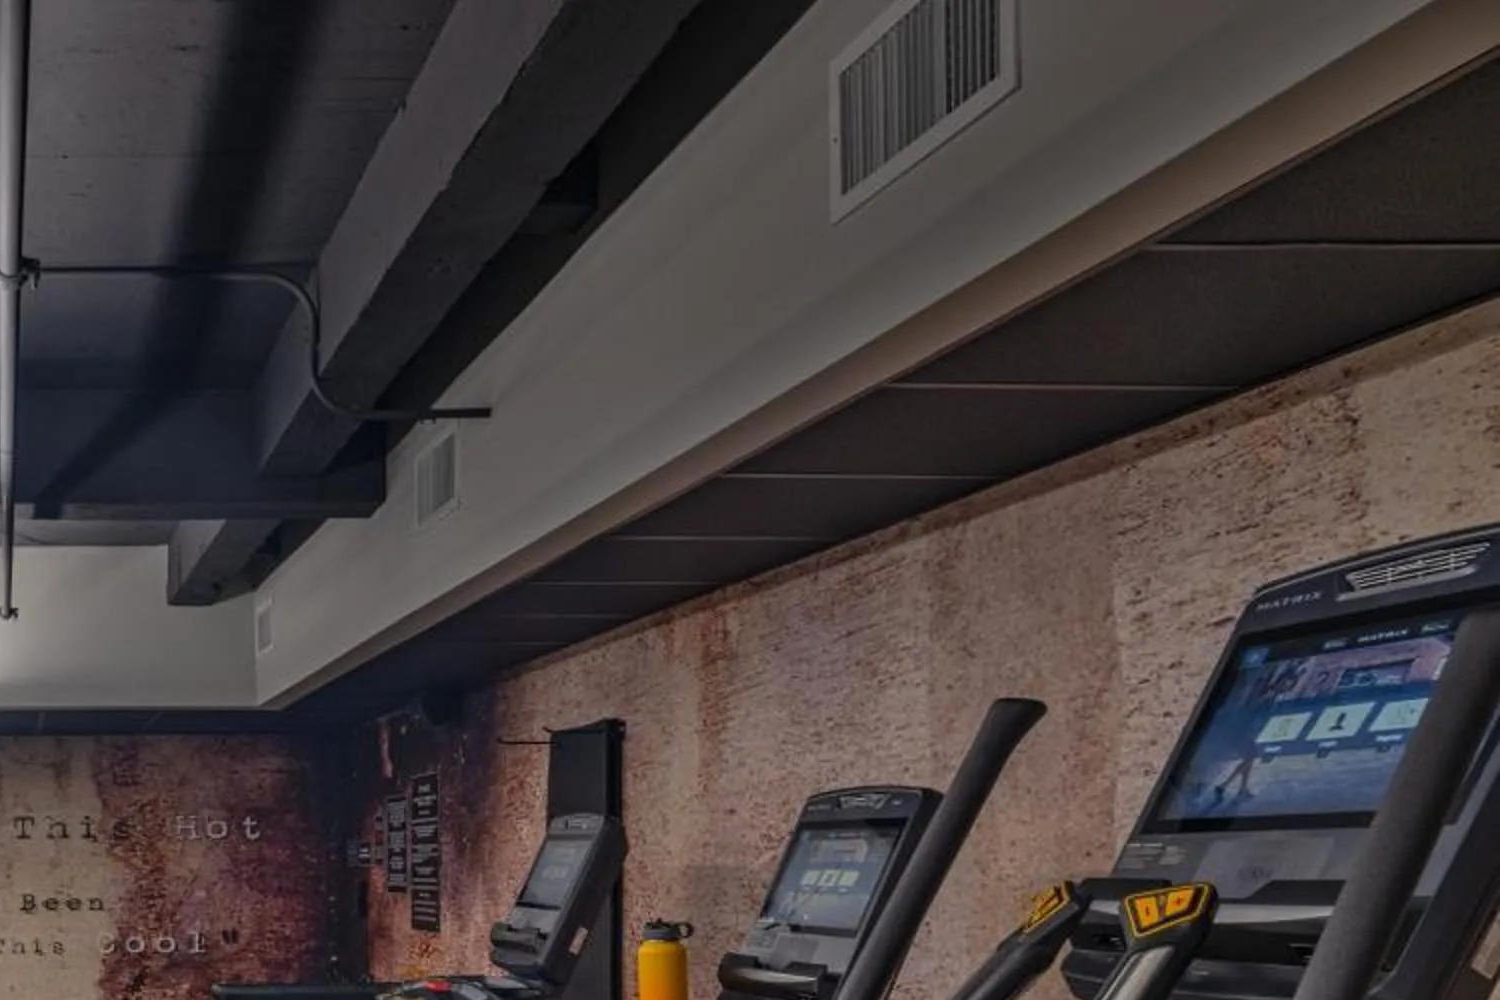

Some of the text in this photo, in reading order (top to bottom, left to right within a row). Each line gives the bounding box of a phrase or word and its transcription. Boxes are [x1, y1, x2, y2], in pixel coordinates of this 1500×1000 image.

[13, 815, 132, 842] This
[174, 815, 261, 840] Hot
[19, 893, 106, 914] Been
